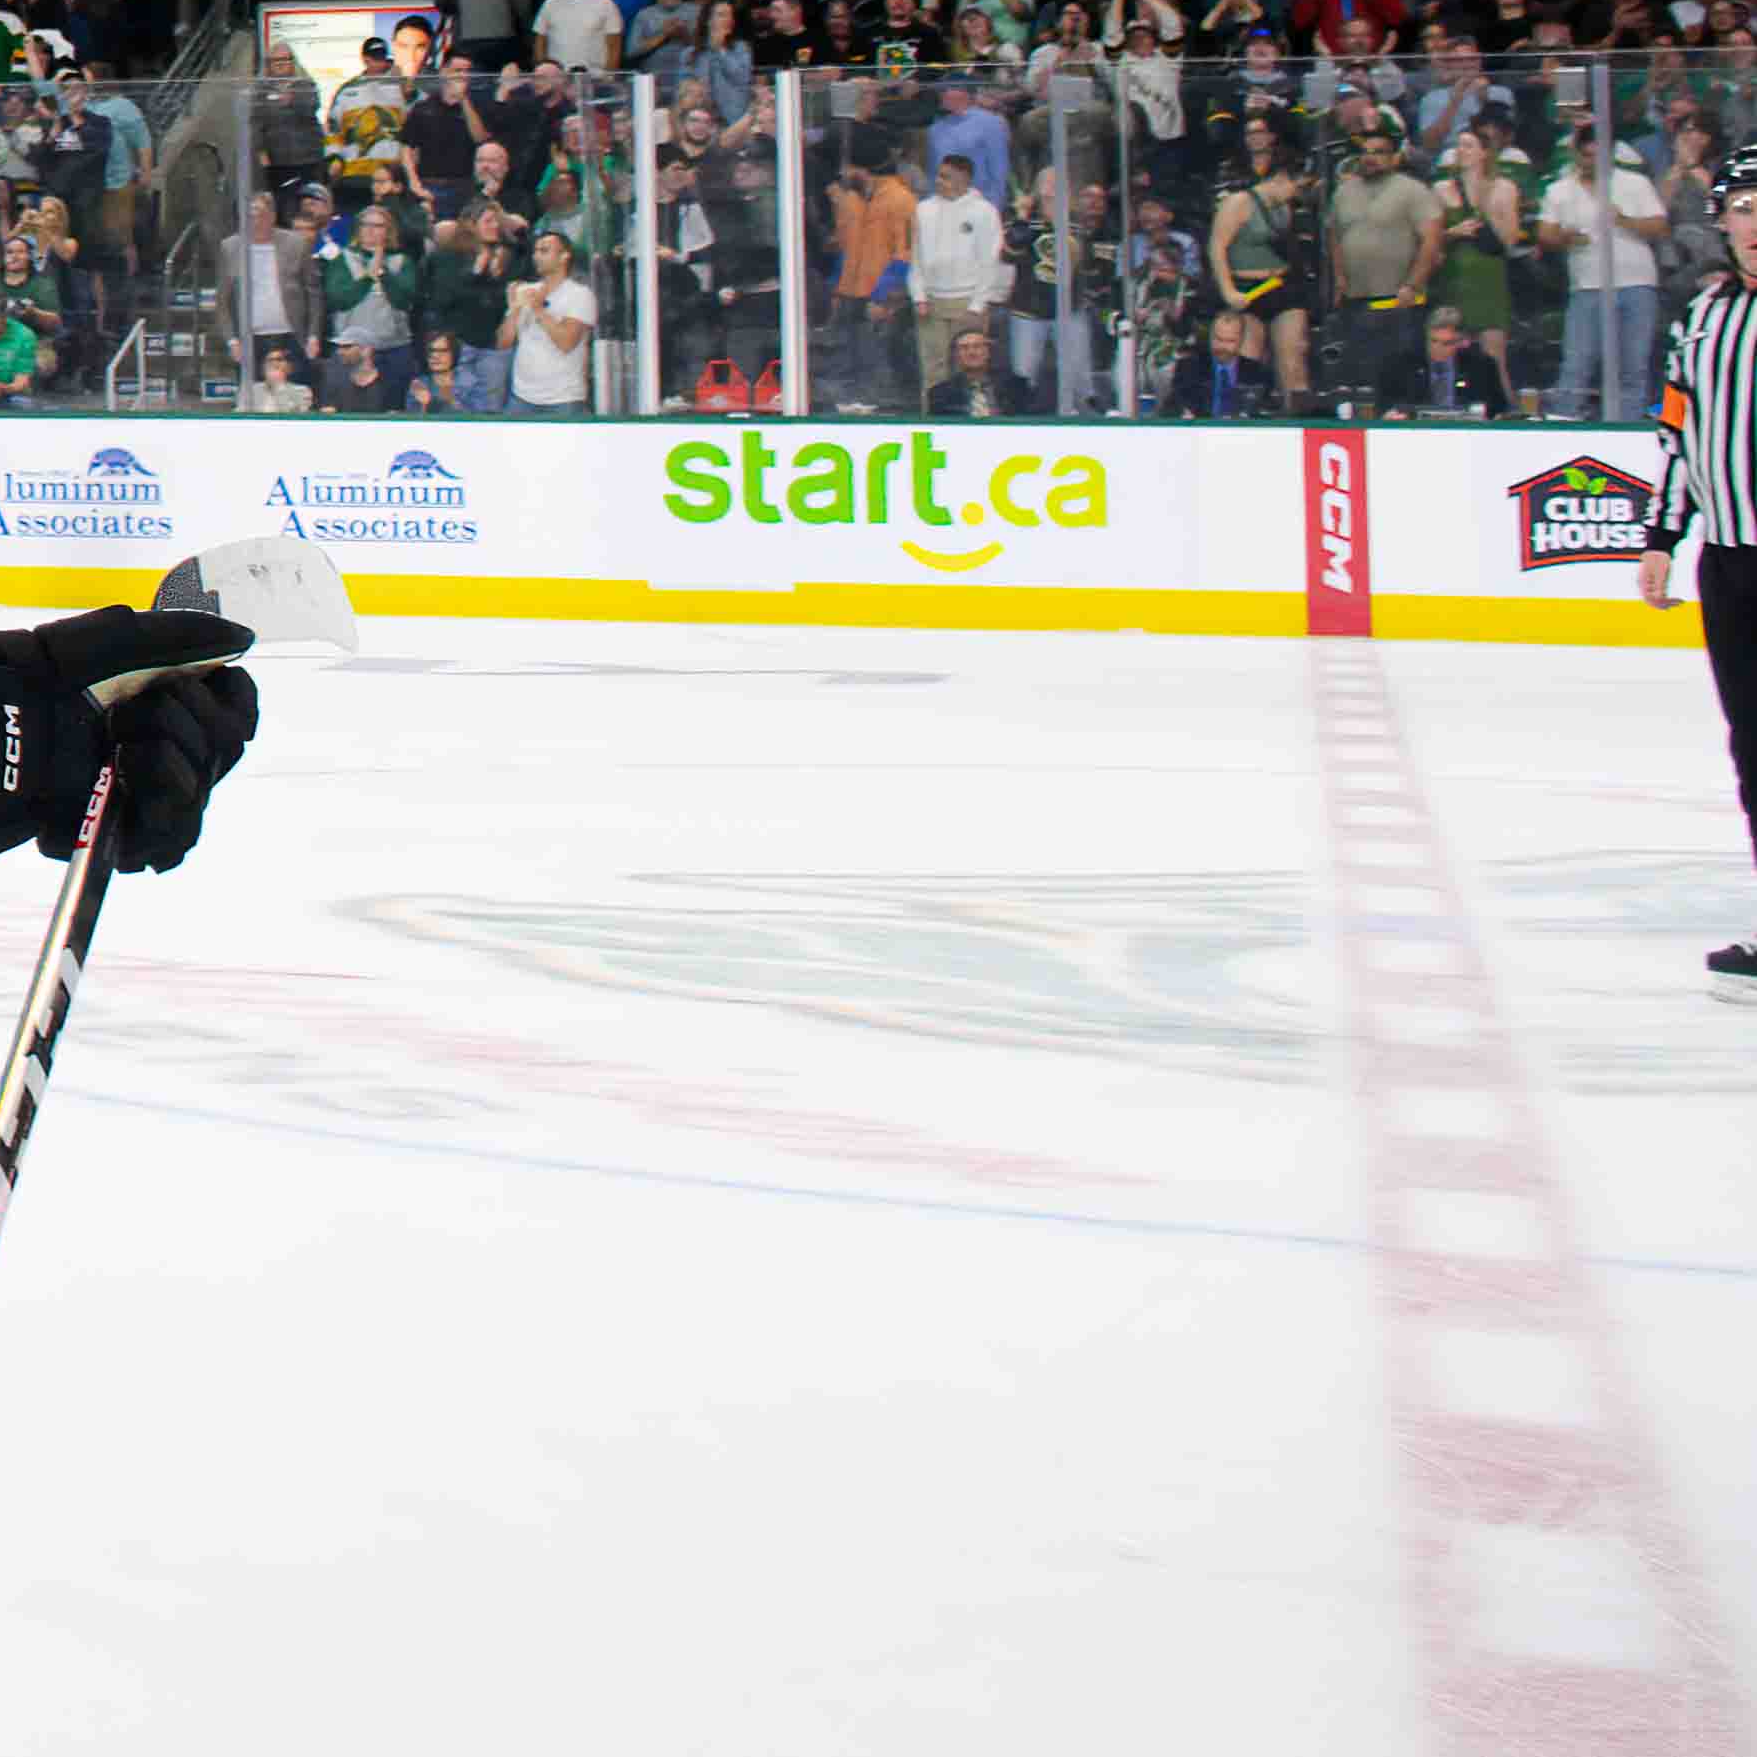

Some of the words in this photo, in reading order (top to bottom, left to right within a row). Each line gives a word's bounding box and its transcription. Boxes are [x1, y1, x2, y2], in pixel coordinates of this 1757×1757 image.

[264, 476, 464, 506] Aluminum
[663, 430, 1106, 527] start.ca
[280, 510, 478, 541] Associates
[1320, 441, 1352, 594] CCM
[1544, 496, 1634, 522] CLUB
[1531, 522, 1647, 552] HOUSE
[3, 704, 22, 792] CCM
[78, 766, 112, 843] CCM
